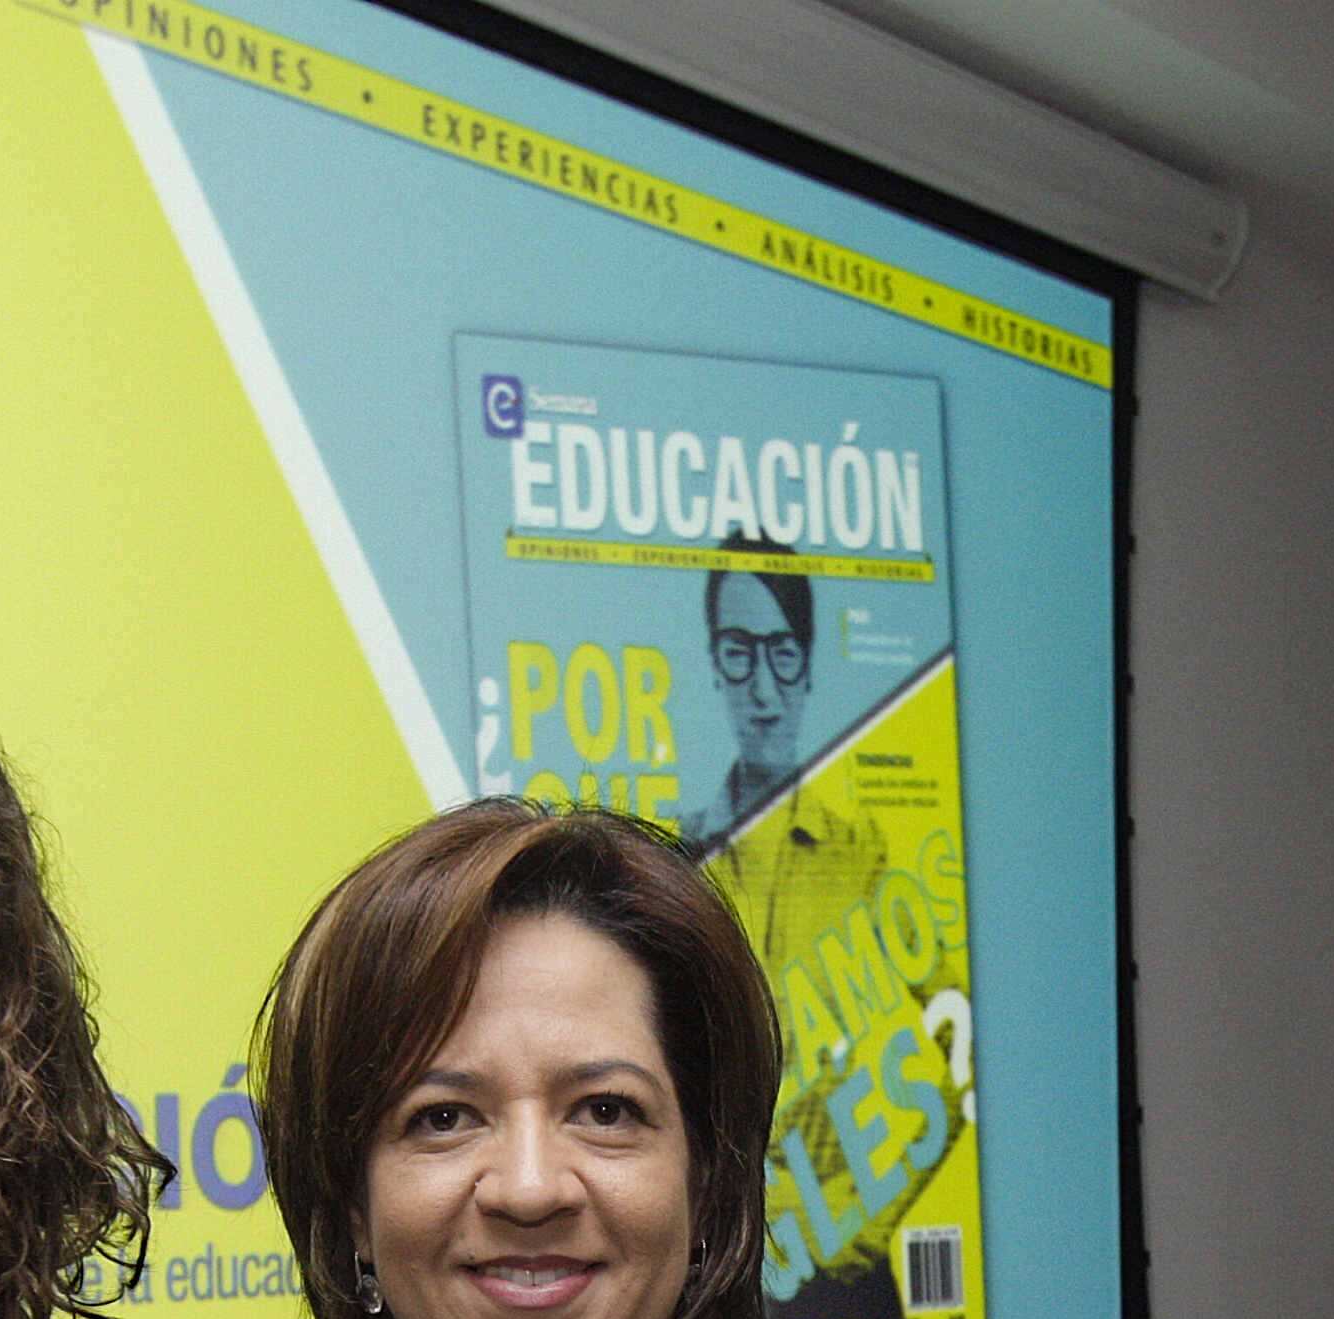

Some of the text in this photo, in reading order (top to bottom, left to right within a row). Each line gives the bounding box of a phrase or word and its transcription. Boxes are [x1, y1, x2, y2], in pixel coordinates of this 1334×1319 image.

[59, 0, 1093, 377] PINIONES EXPERIENCIAS ANÁLISIS HISTORIAS
[512, 420, 924, 552] EDUCACIÓN
